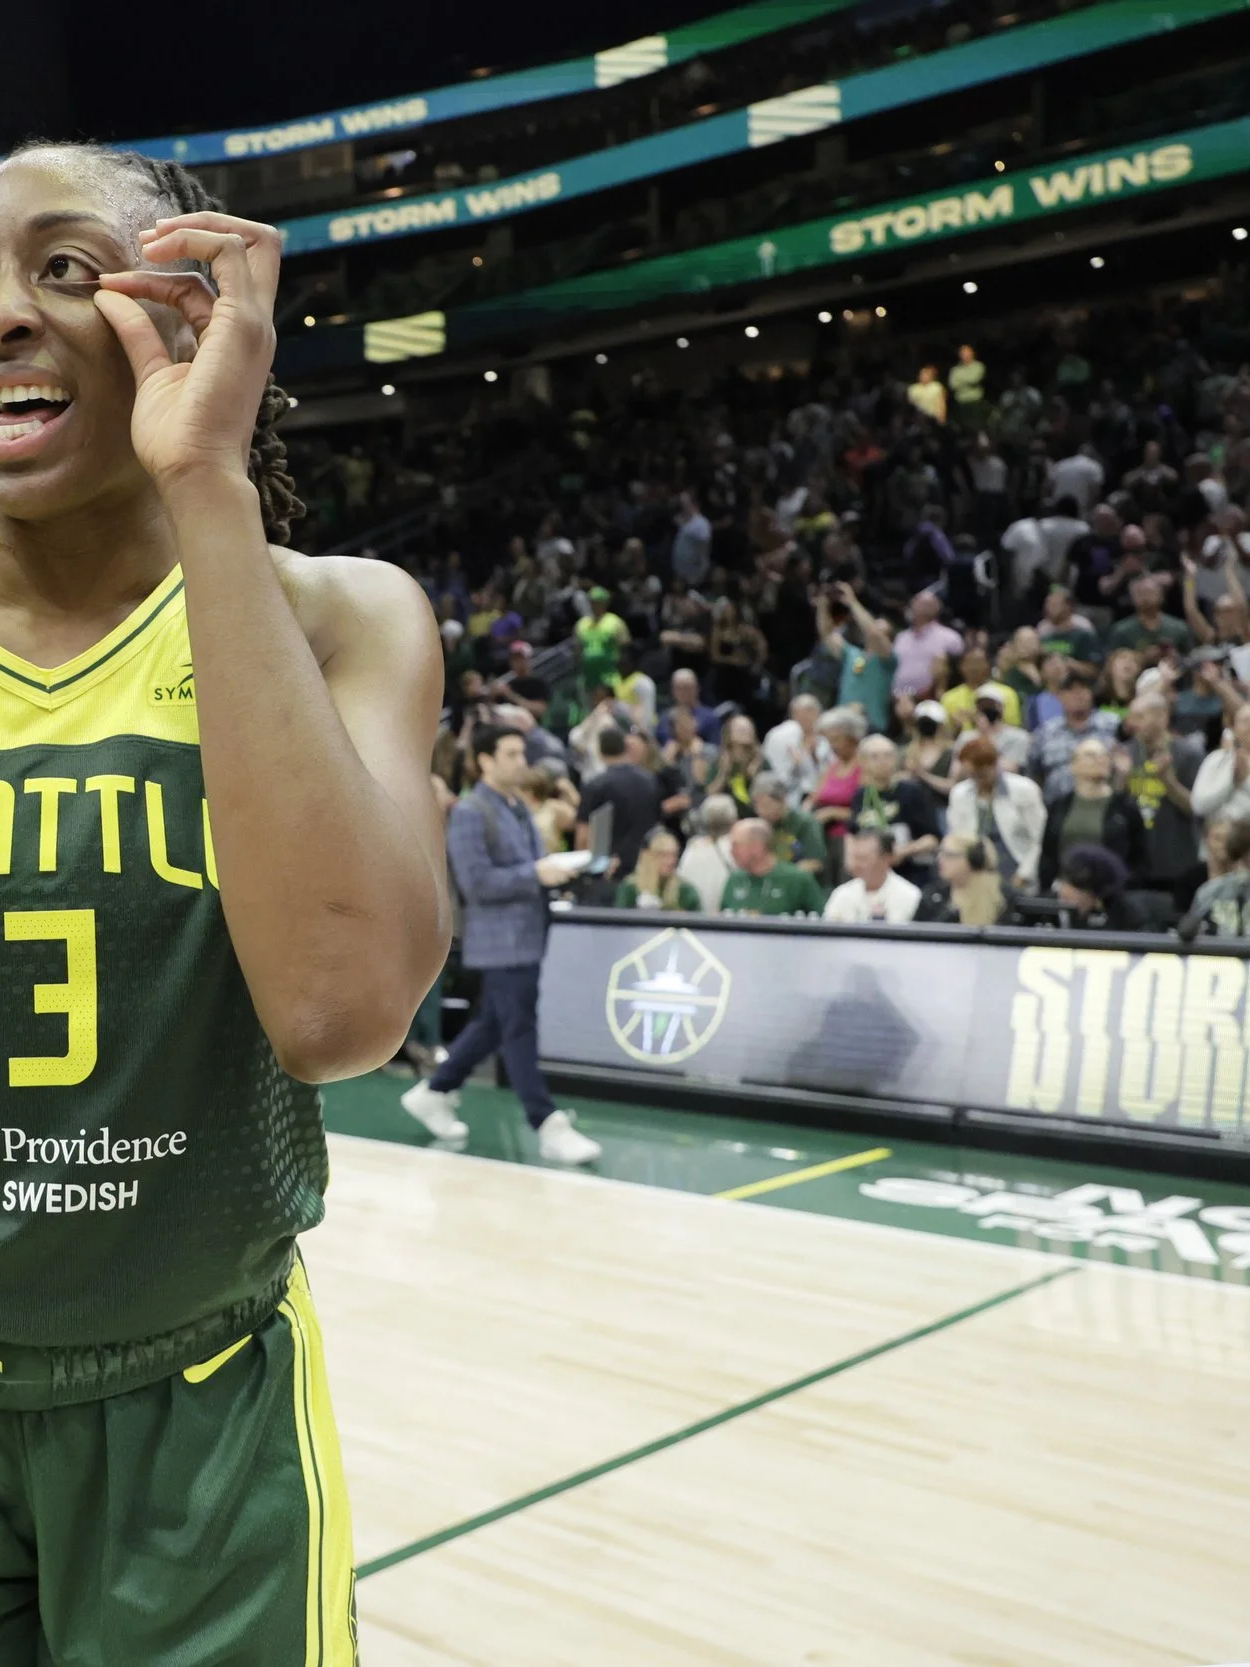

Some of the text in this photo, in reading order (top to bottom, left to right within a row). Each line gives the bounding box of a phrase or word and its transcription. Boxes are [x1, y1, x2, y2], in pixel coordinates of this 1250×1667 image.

[223, 98, 428, 157] STORM WINS
[329, 172, 562, 242] STORM WINS
[829, 144, 1193, 254] STORM WINS
[4, 909, 98, 1088] 3
[1006, 946, 1250, 1132] STOR
[1, 1127, 187, 1165] Providence
[2, 1179, 139, 1214] SWEDISH
